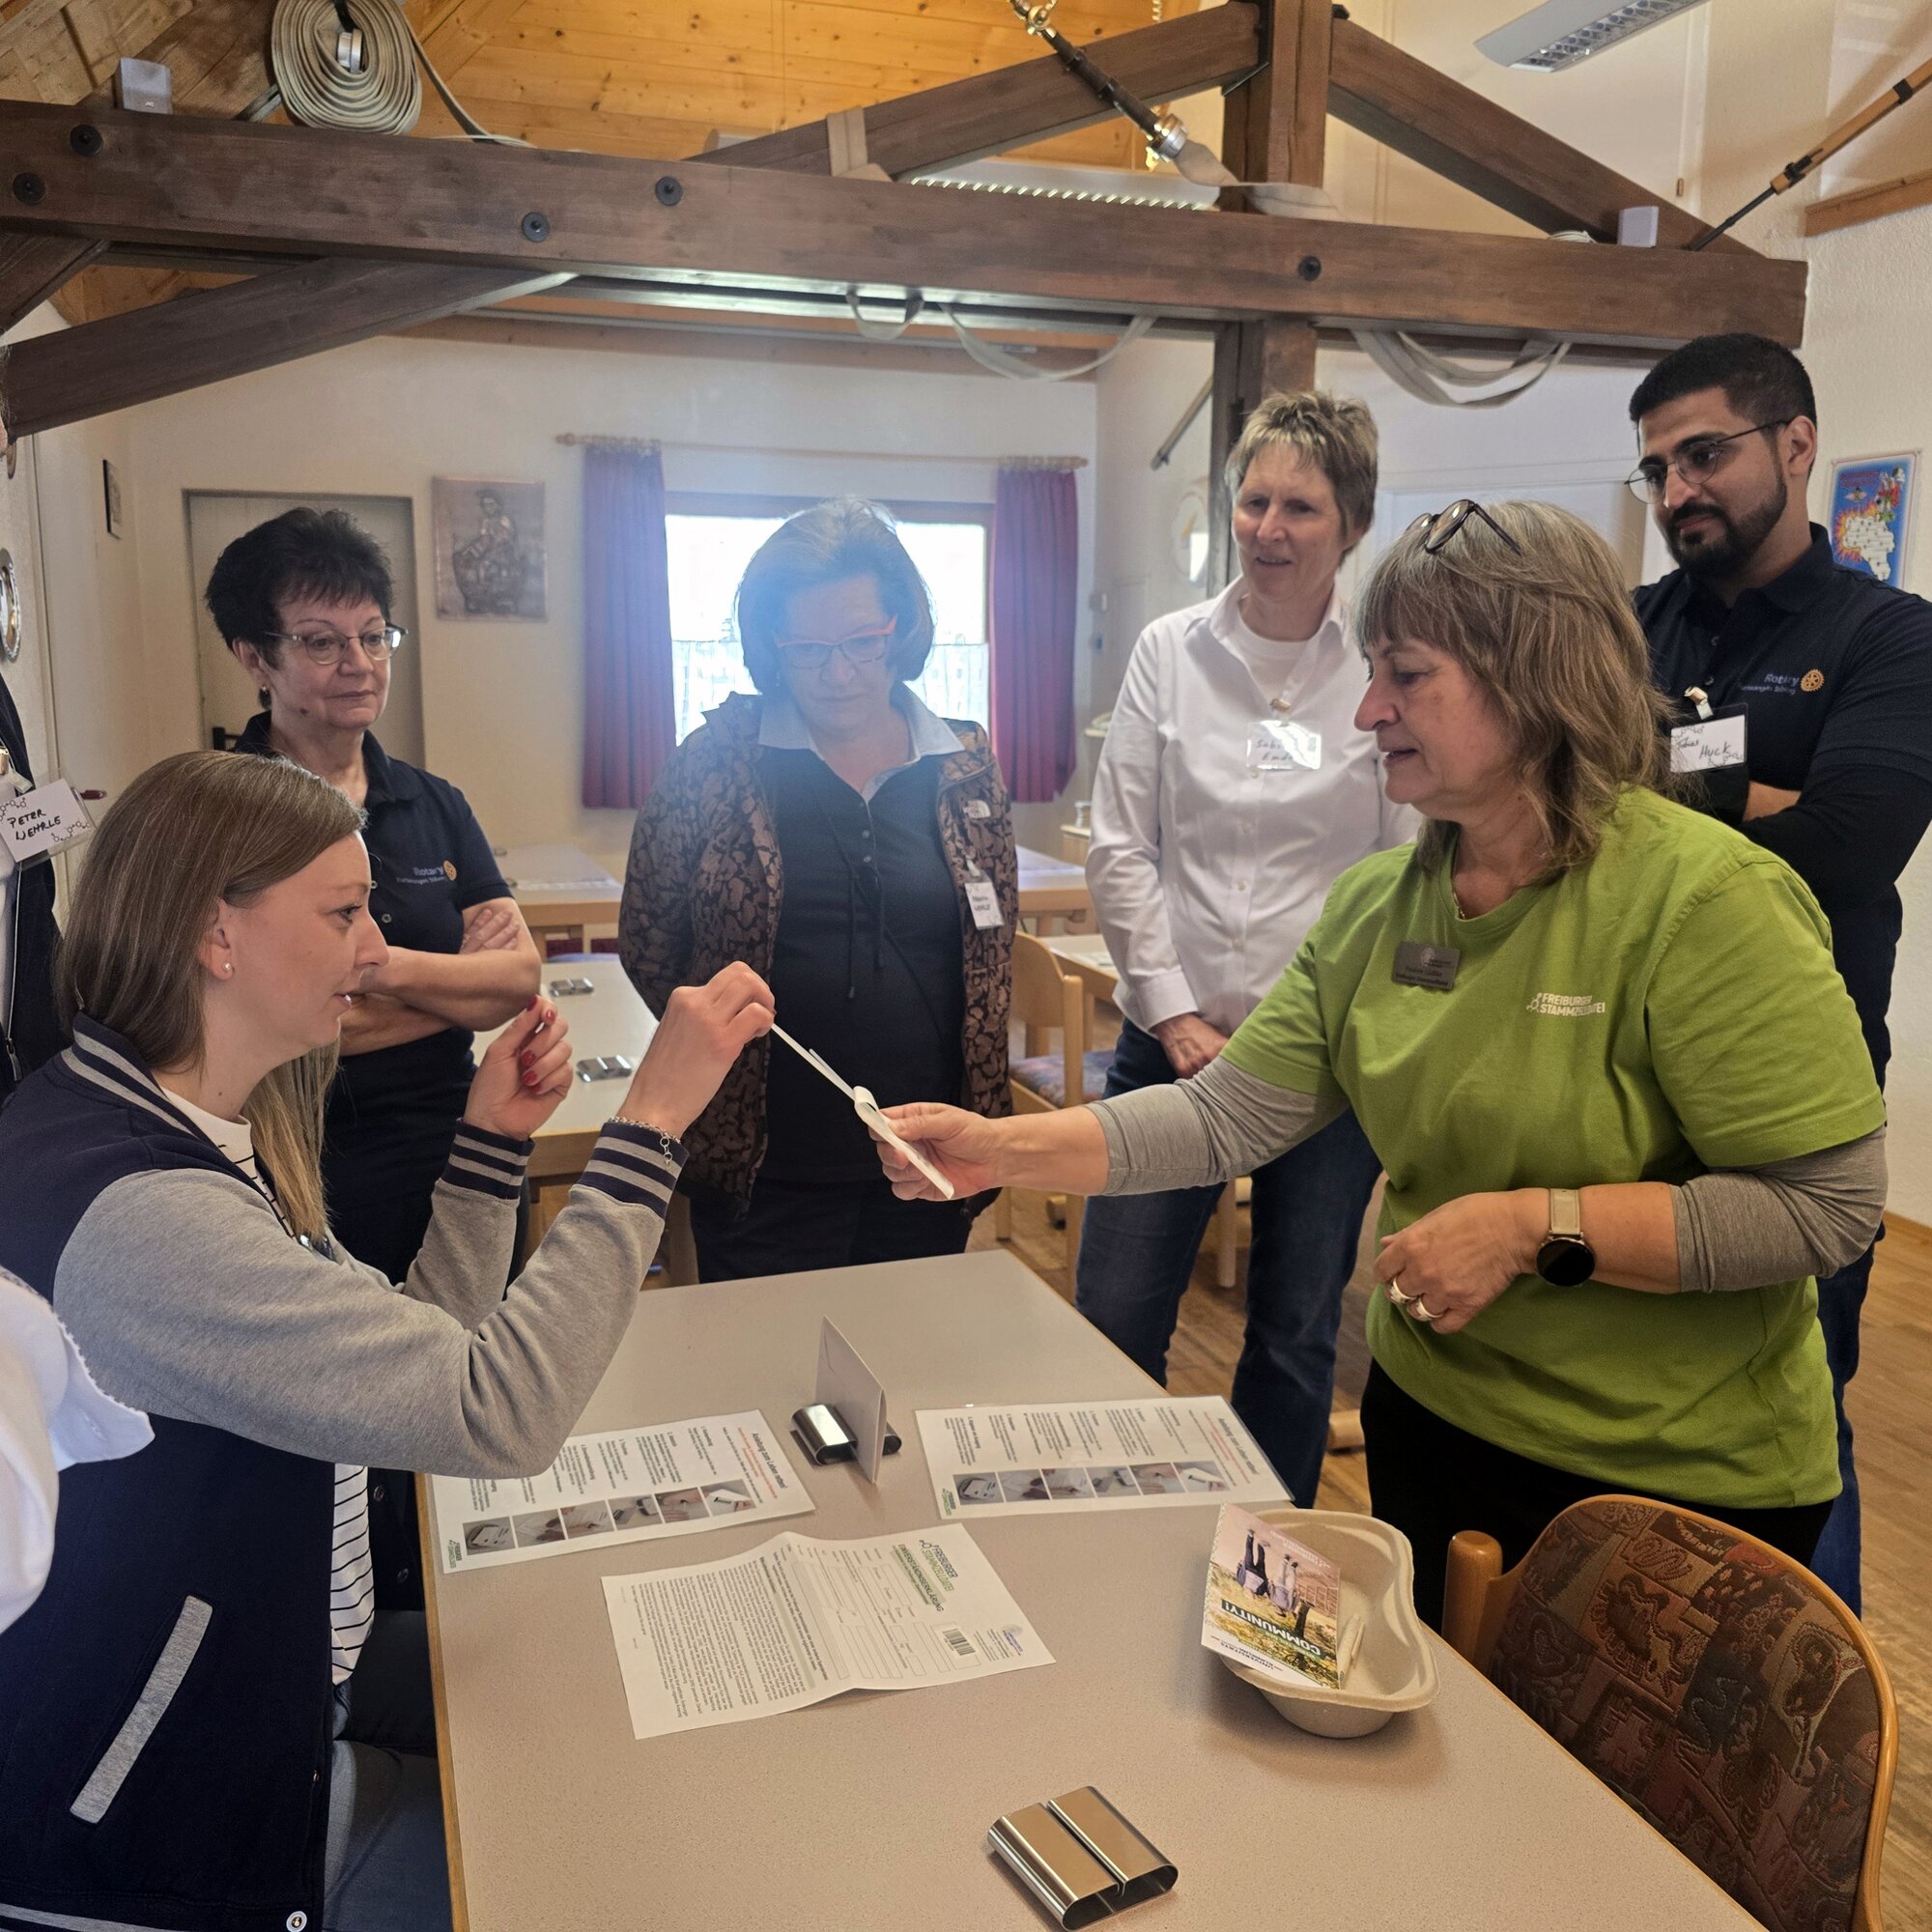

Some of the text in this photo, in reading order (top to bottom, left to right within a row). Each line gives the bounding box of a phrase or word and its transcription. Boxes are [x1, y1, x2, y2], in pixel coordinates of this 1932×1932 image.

[1765, 673, 1800, 687] Rotary
[7, 809, 46, 829] PETER
[1542, 992, 1593, 1007] FREIBURGER
[766, 1460, 780, 1475] Leben
[1225, 1601, 1321, 1656] COMMUNITY!
